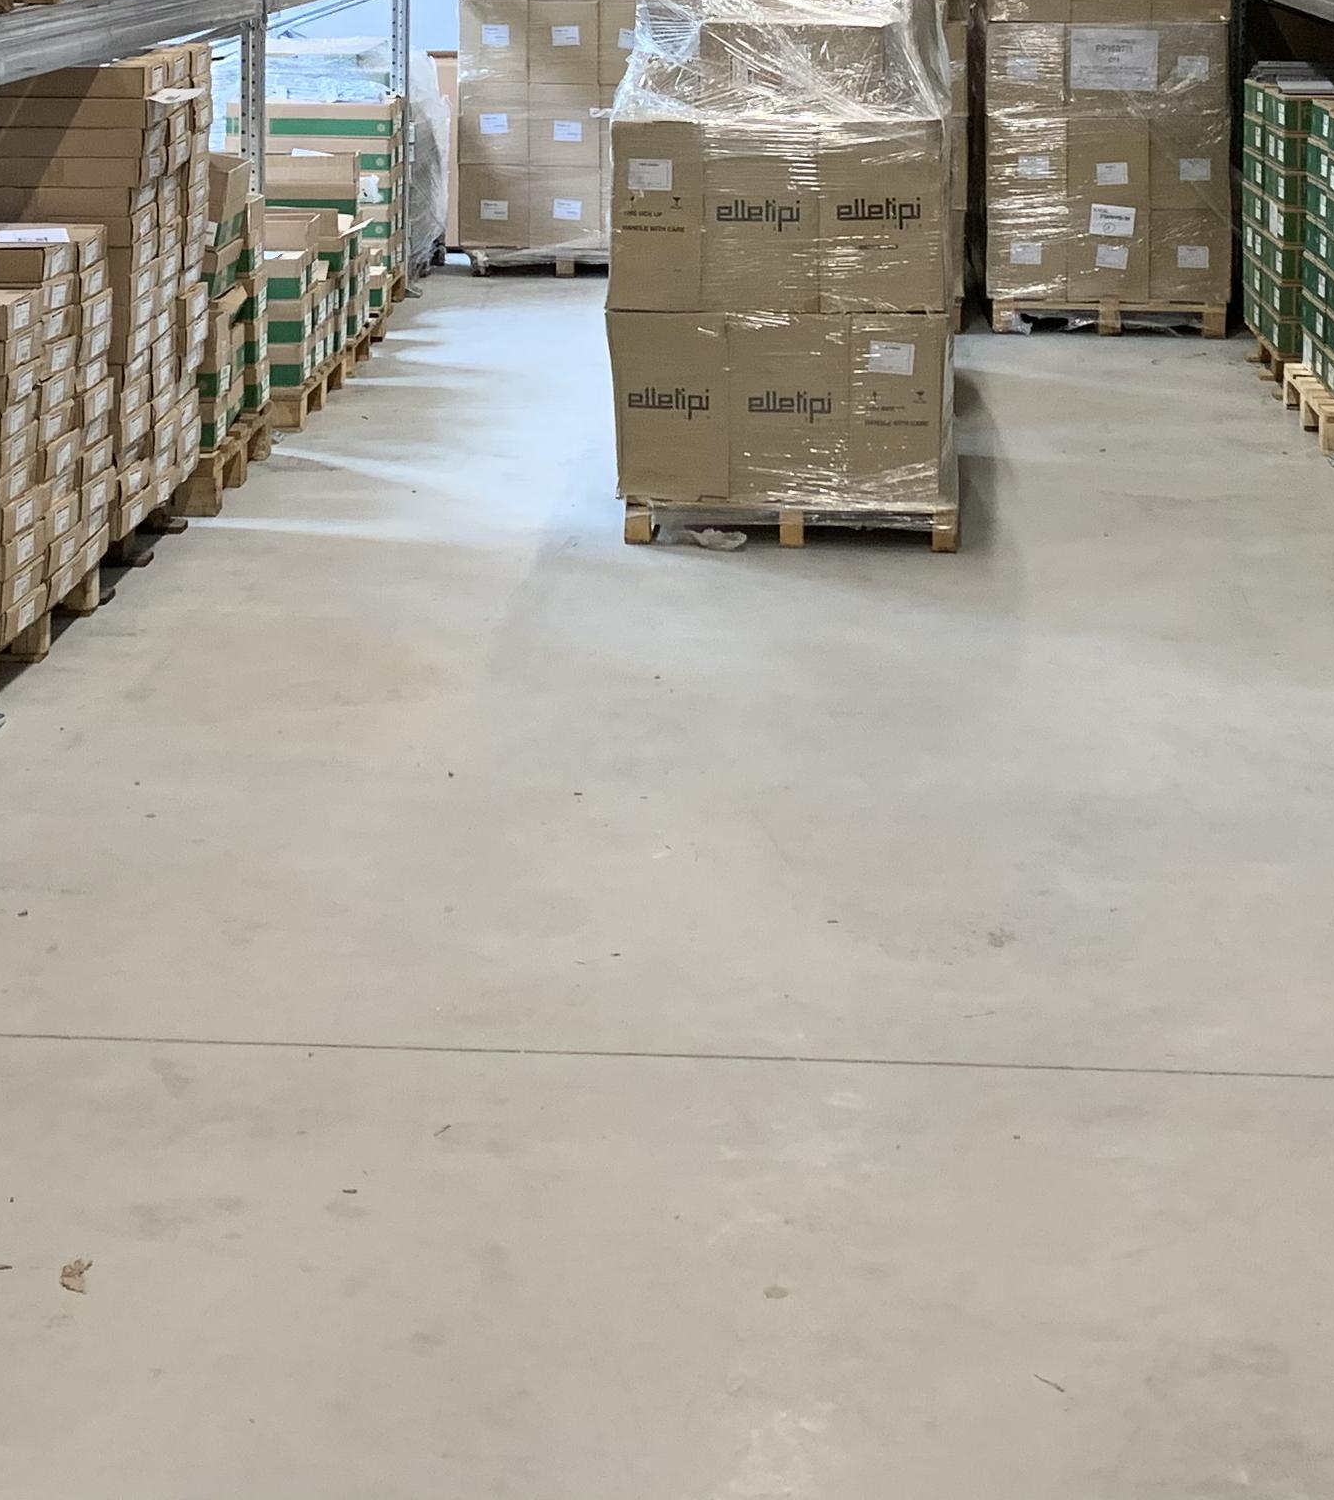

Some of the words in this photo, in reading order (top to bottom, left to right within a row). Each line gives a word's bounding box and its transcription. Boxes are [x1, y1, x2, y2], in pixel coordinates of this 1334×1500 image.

[716, 200, 801, 232] elletipi
[836, 197, 921, 230] elletipi
[628, 387, 709, 421] elletipi
[748, 390, 832, 424] elletipi
